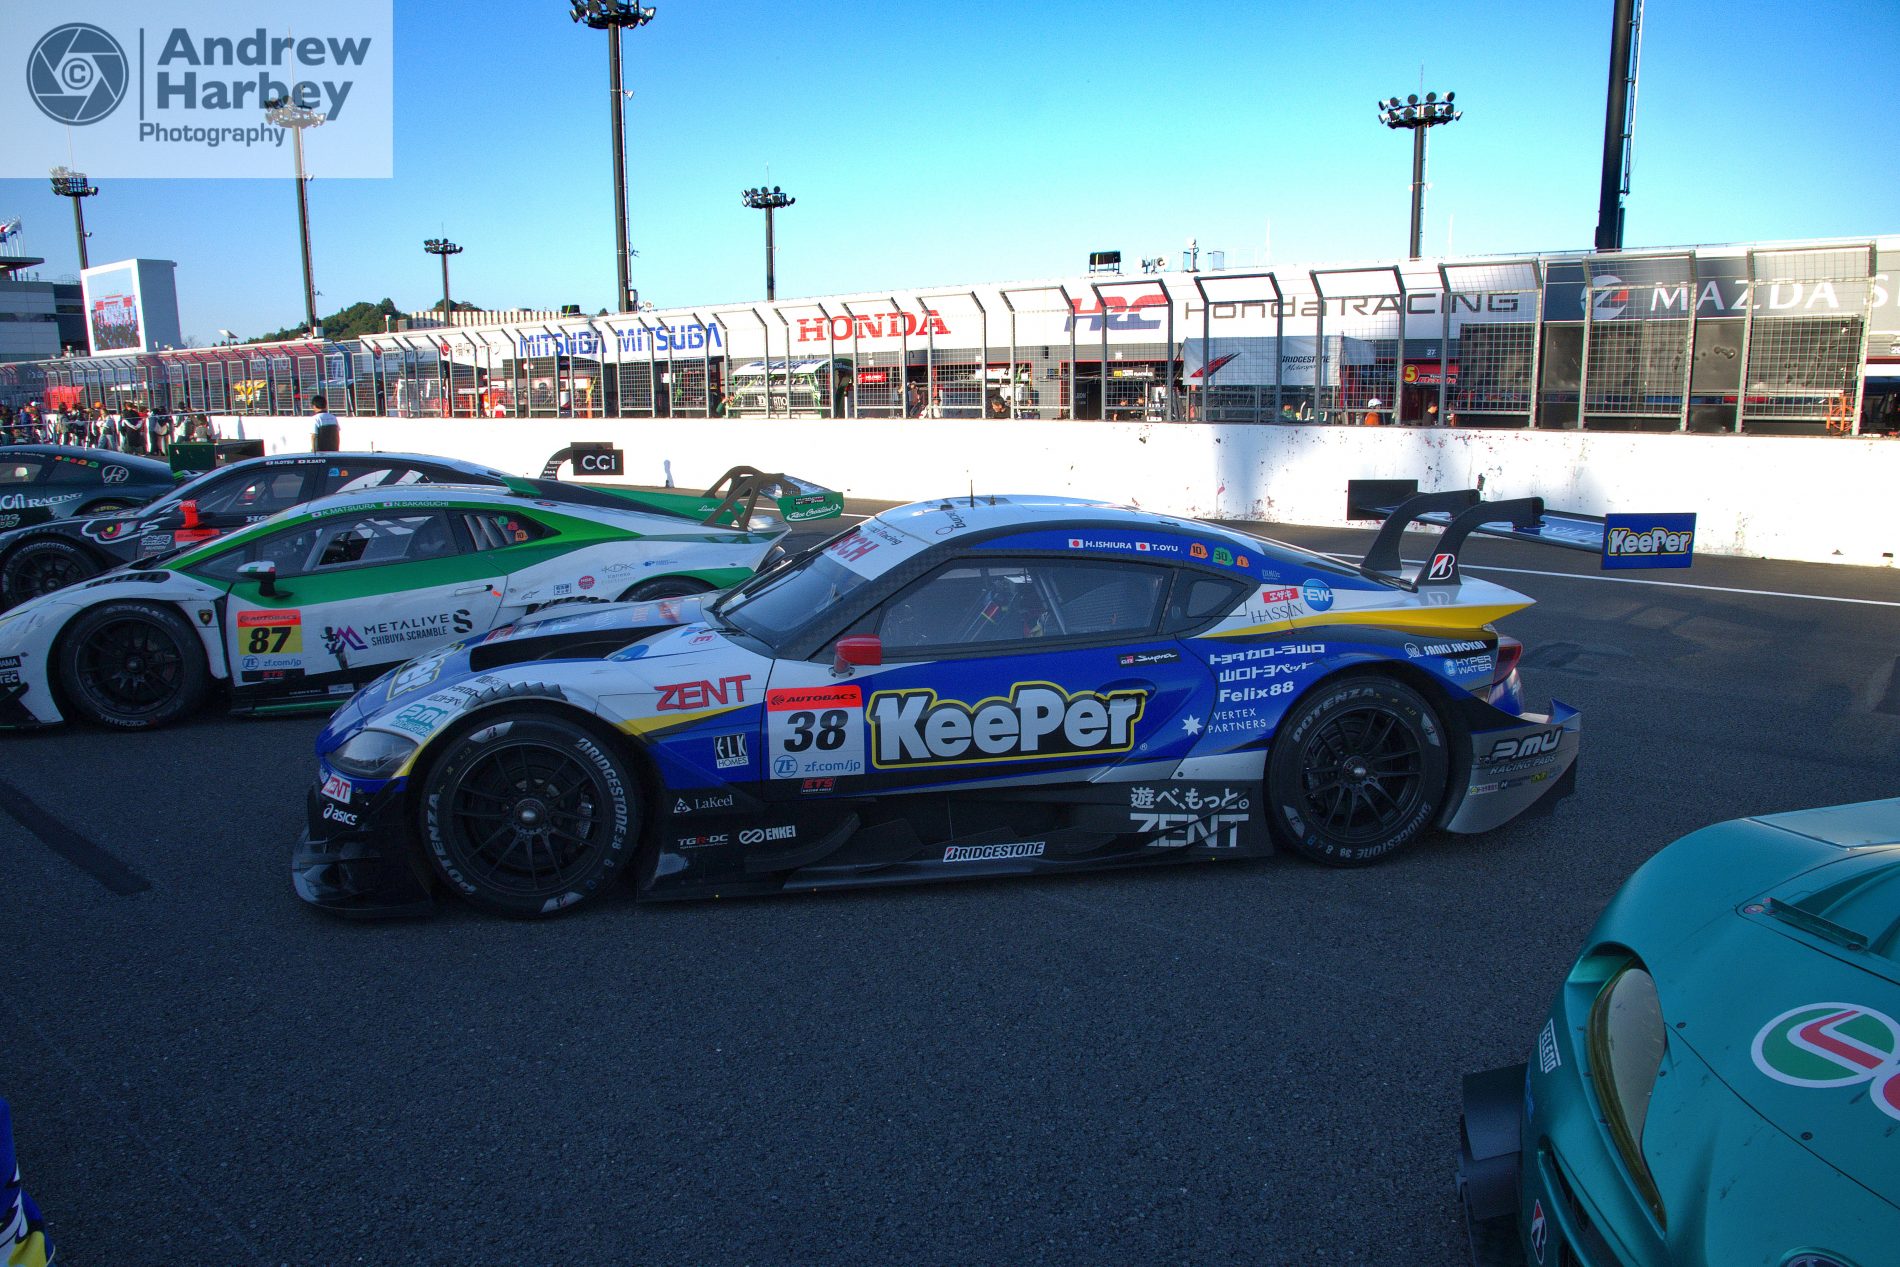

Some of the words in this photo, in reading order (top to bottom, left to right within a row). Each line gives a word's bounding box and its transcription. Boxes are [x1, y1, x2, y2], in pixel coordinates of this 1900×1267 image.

[1650, 279, 1840, 312] MAZDA
[1185, 297, 1326, 320] Honda
[1340, 293, 1519, 316] RACING
[797, 309, 952, 342] HONDA
[519, 331, 607, 357] MITSUBA
[617, 322, 722, 352] MITSUBA
[1403, 365, 1415, 382] 5
[28, 492, 83, 507] RACING
[394, 500, 449, 508] N.SAKAGUCHI
[322, 503, 376, 516] K.MATSUURA
[1085, 540, 1132, 549] H.ISHIURA
[1152, 543, 1178, 552] T.OYU
[1192, 546, 1202, 555] 10
[1610, 530, 1690, 554] KeePer
[1306, 588, 1330, 602] EW
[249, 614, 297, 622] AUTOBACS
[364, 614, 450, 635] METALIVE
[248, 626, 292, 654] 87
[371, 632, 405, 646] SHIBUYA
[407, 626, 448, 641] SCRAMBLE
[1209, 644, 1325, 665] トヨタカローラ山口
[1423, 644, 1452, 656] SANKI
[1451, 640, 1487, 652] SHOKAI
[263, 658, 302, 667] zf.com/jp
[1135, 653, 1177, 663] Supra
[1455, 655, 1492, 666] HYPER
[1219, 661, 1315, 682] 山口トヨペット
[1457, 663, 1492, 675] WATER
[654, 674, 751, 711] ZENT
[786, 693, 857, 703] AUTOBACS
[1219, 681, 1294, 703] Felix88
[1213, 708, 1257, 720] VERTEX
[784, 709, 849, 752] 38
[875, 688, 1137, 761] KeePer
[1208, 718, 1267, 733] PARTNERS
[718, 757, 747, 767] HOMES
[775, 757, 796, 775] ZF
[804, 759, 861, 773] zf.com/jp
[575, 737, 628, 836] BRIDGESTONE
[1130, 787, 1250, 810] 遊べ、もっと。
[332, 808, 358, 826] asics
[765, 825, 796, 841] ENKEI
[1129, 813, 1249, 847] ZENT
[677, 834, 729, 846] TGR-DC
[943, 841, 1045, 862] BRIDGESTONE
